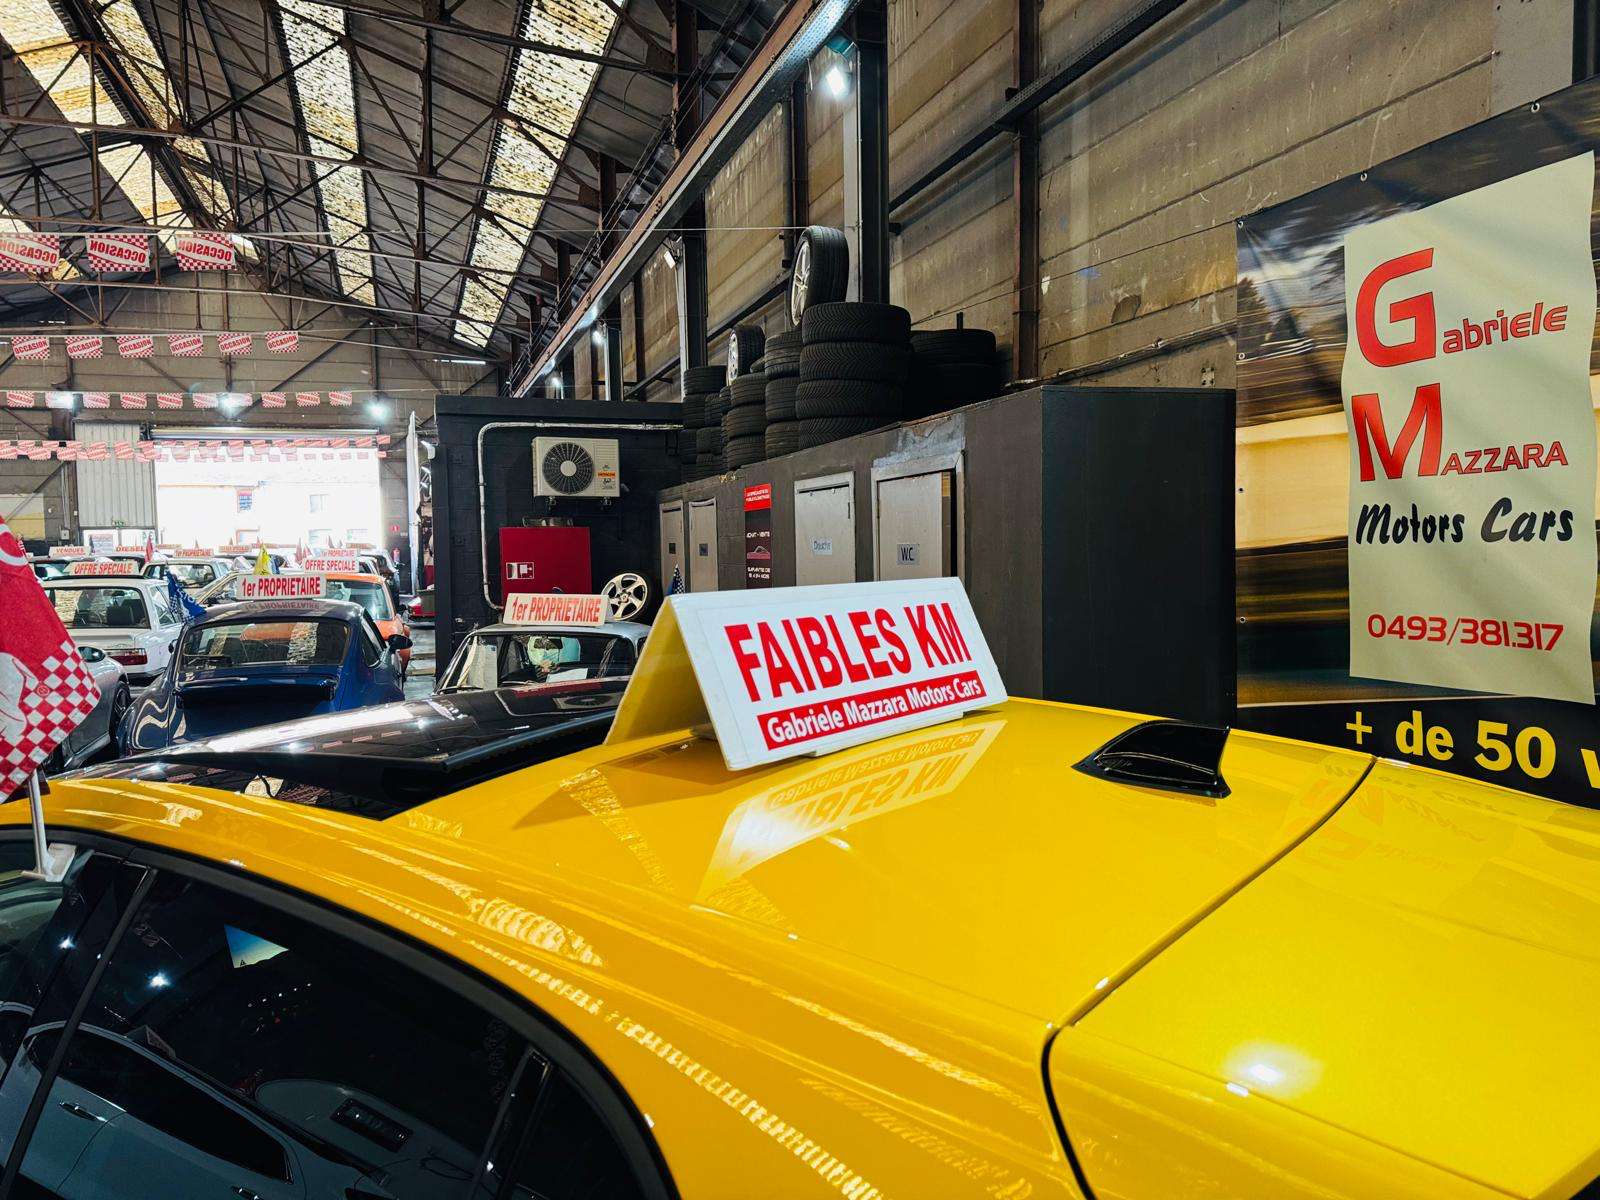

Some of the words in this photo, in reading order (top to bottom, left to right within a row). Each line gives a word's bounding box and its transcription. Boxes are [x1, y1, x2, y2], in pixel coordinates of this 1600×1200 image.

[15, 341, 47, 354] OCCASION
[68, 339, 100, 354] OCCASION
[120, 339, 151, 353] OCCASION
[171, 337, 201, 352] OCCASION
[220, 336, 250, 350] OCCASION
[268, 335, 297, 349] OCCASION
[1355, 503, 1465, 544] Motors
[1480, 497, 1574, 543] Cars
[74, 562, 97, 574] OFFRE
[99, 561, 133, 574] SPECIALE
[305, 560, 325, 570] OFFRE
[327, 560, 356, 571] SPECIALE
[242, 578, 255, 597] 1er
[258, 576, 320, 596] PROPRIETAIRE
[511, 597, 528, 621] 1er
[528, 597, 602, 622] PROPRIETAIRE
[1367, 614, 1564, 652] 0493/381.317
[724, 608, 912, 702] FAIBLES
[904, 602, 972, 669] KM
[766, 709, 845, 743] Gabriele
[842, 696, 908, 725] Mazzara
[905, 683, 955, 710] Motors
[953, 677, 982, 698] Cars
[1395, 710, 1454, 761] de
[1474, 719, 1557, 779] 50
